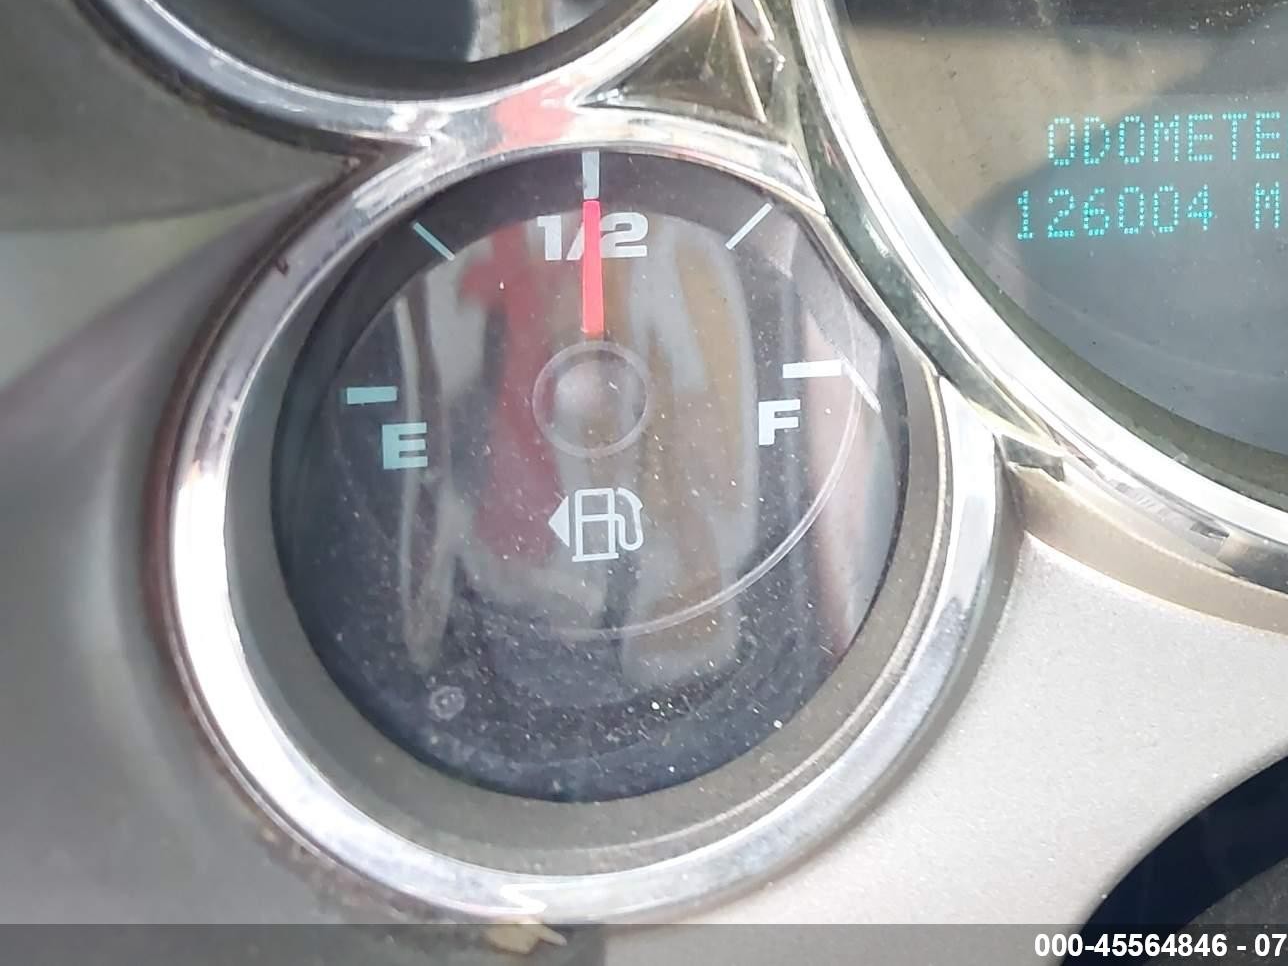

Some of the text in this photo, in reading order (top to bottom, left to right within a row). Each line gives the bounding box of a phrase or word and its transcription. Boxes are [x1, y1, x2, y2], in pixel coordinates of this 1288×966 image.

[1017, 184, 1215, 240] 126004
[536, 212, 648, 261] 1/2
[382, 422, 428, 470] E
[758, 399, 800, 445] F
